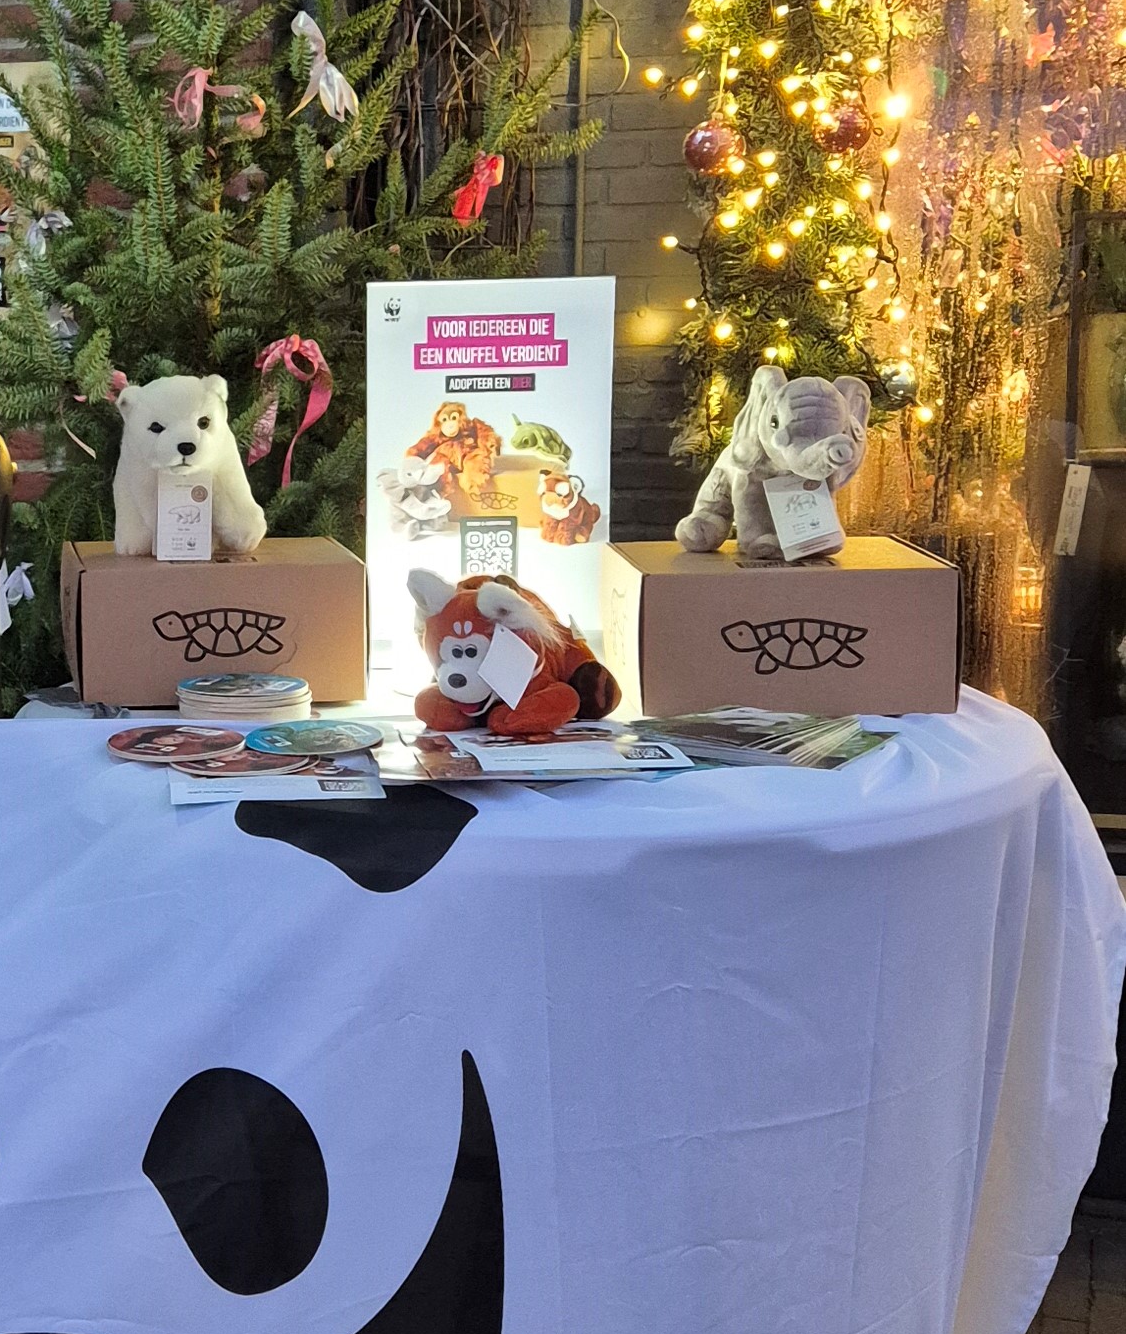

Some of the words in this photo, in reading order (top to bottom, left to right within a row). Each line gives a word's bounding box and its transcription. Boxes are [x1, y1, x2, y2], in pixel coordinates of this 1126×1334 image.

[432, 320, 466, 338] VOOR
[469, 318, 527, 337] IEDEREEN
[529, 318, 550, 336] DIE
[419, 347, 443, 365] EEN
[446, 346, 499, 364] KNUFFEL
[502, 344, 562, 363] VERDIENT
[448, 377, 493, 390] ADOPTEER
[495, 377, 511, 389] EEN
